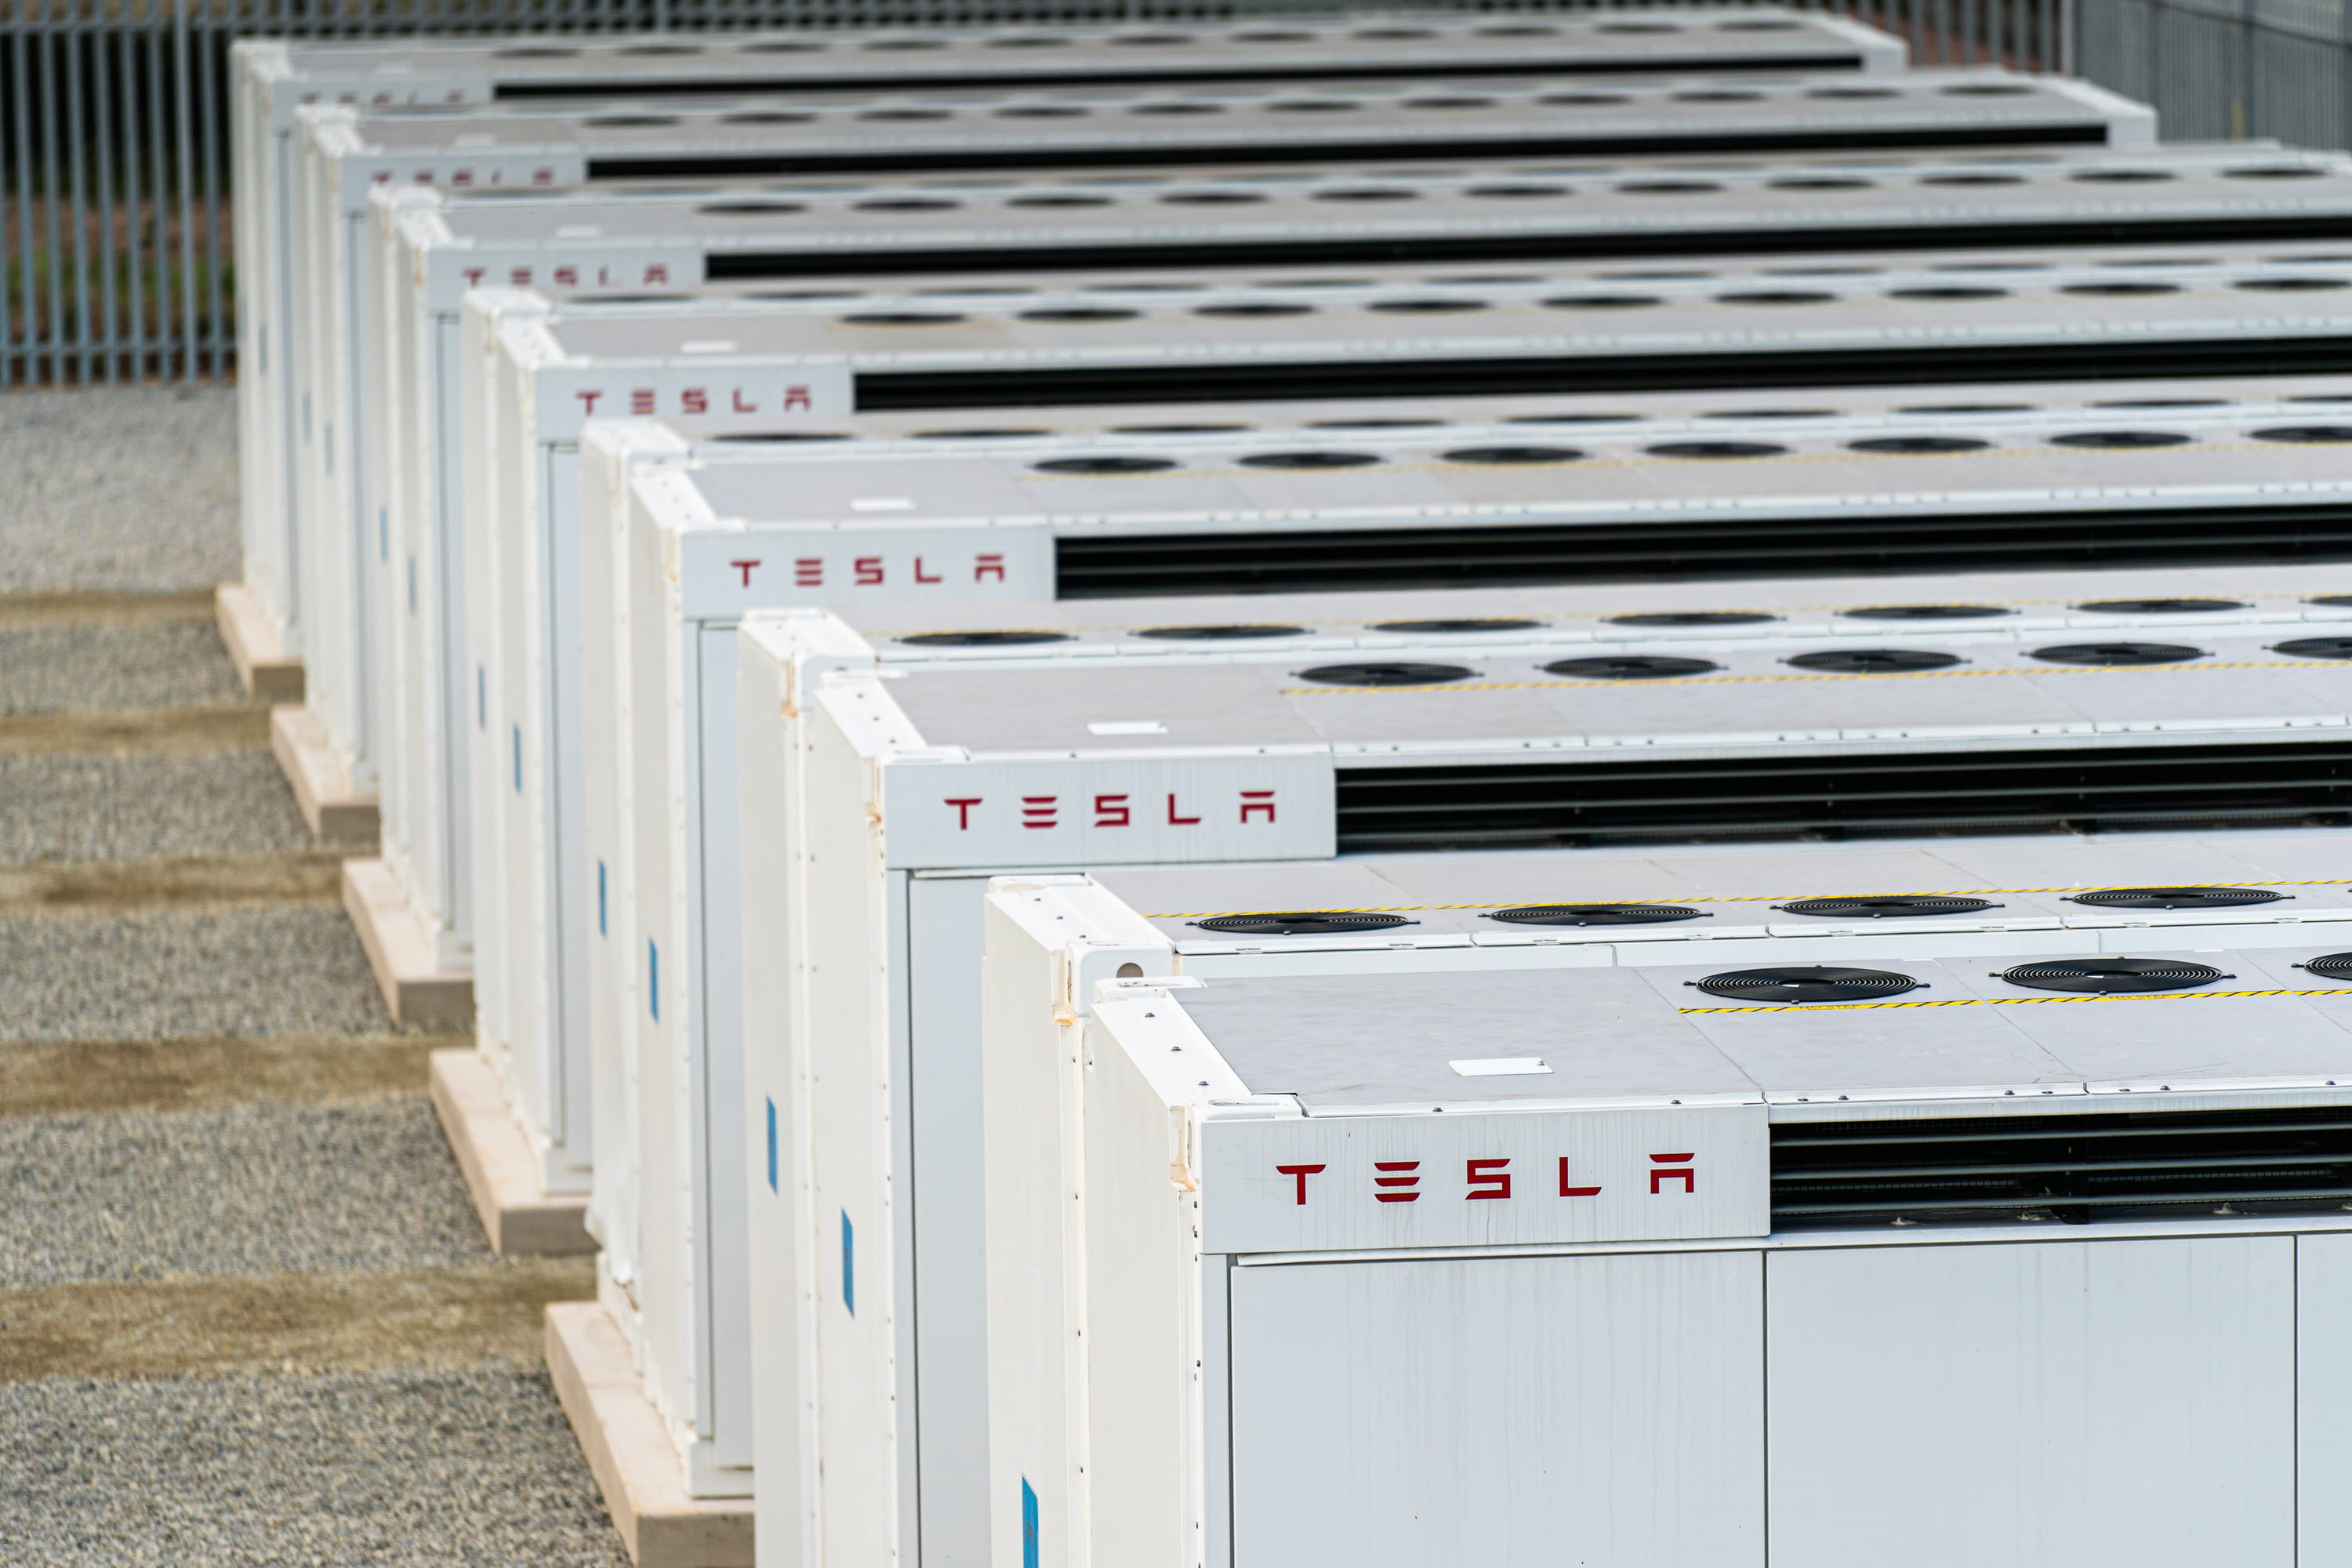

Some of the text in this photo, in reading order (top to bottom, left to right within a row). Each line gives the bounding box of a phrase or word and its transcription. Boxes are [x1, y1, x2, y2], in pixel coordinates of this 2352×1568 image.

[575, 385, 812, 416] TESLA
[731, 554, 1005, 587] TESLA
[945, 791, 1277, 831] TESLA
[1276, 1152, 1696, 1206] TESLA
